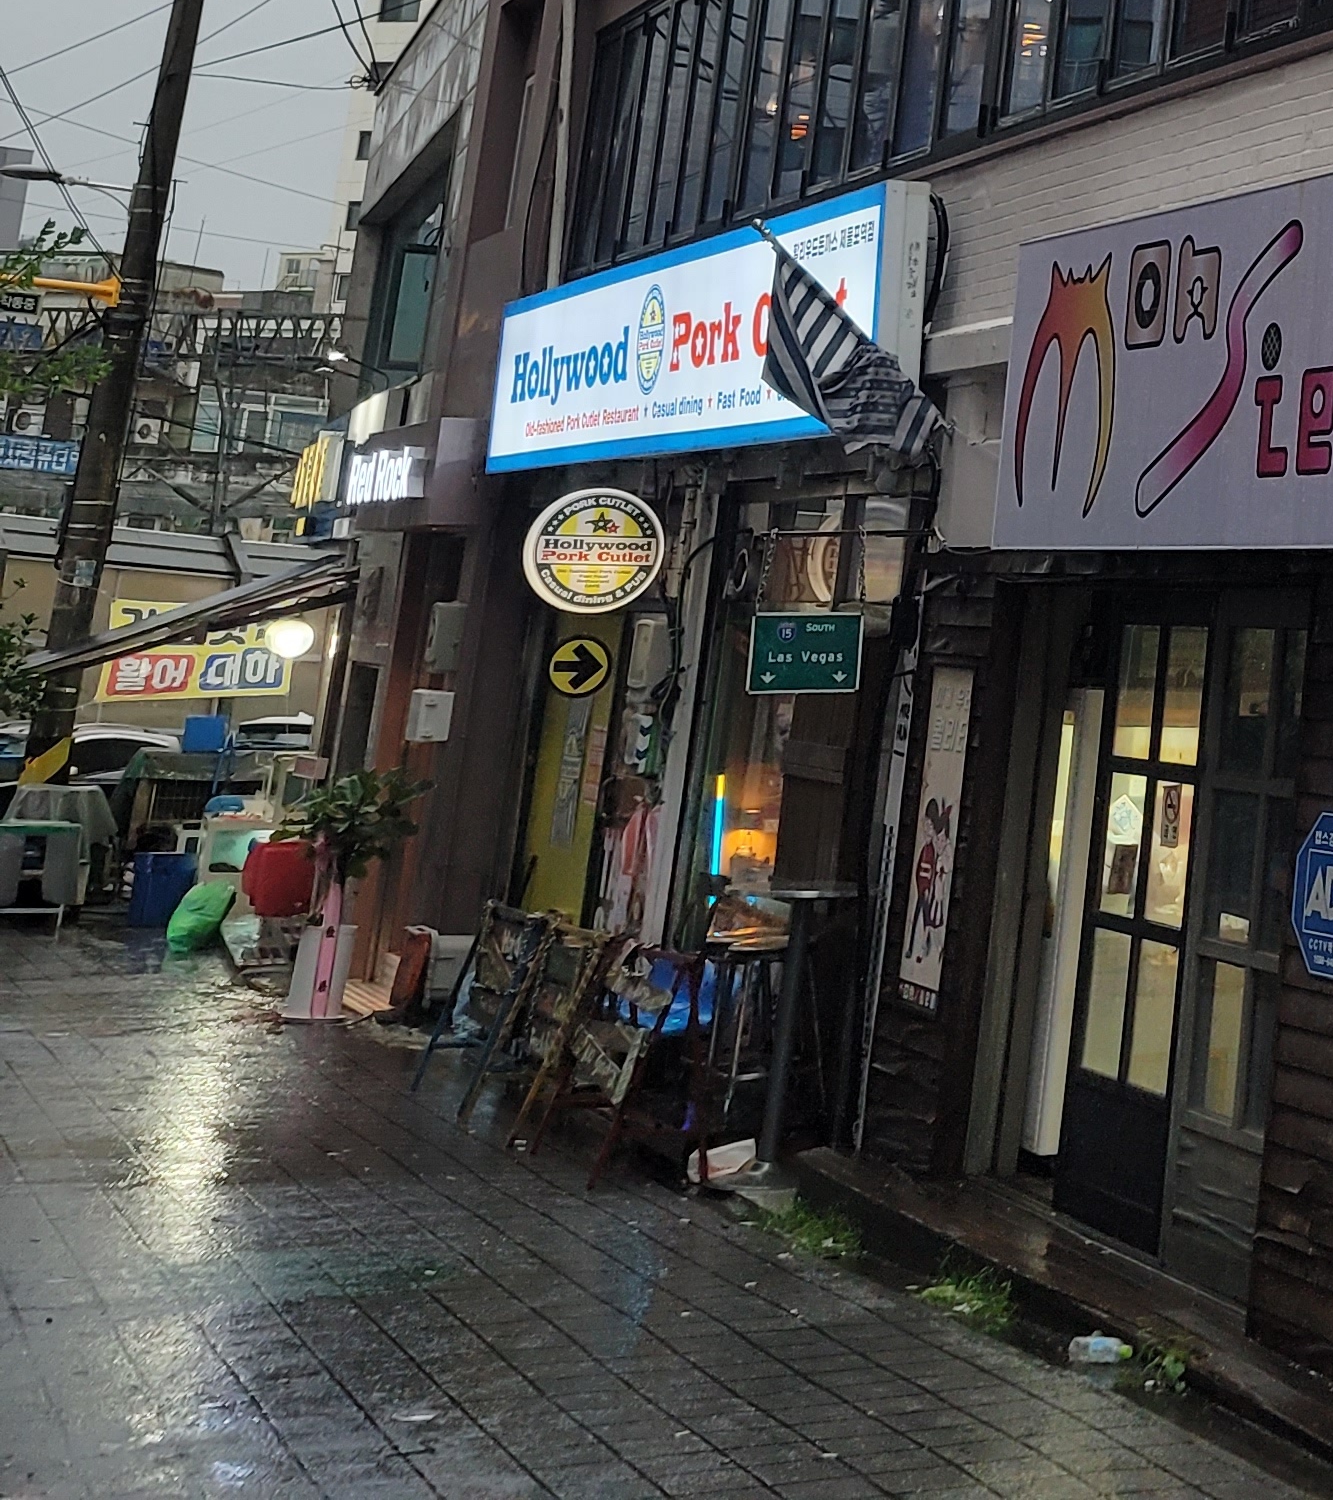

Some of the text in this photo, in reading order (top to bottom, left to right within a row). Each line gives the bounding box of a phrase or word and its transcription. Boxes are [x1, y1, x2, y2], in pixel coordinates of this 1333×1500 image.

[511, 325, 629, 404] Hollywood
[670, 301, 742, 372] Pork
[567, 413, 581, 431] Pork
[582, 410, 601, 428] Cutlet
[602, 405, 639, 424] Restaurant
[651, 399, 677, 419] Casual
[678, 396, 703, 417] dining
[717, 390, 736, 410] Fast
[739, 388, 761, 407] Food
[346, 452, 378, 505] Red
[373, 446, 413, 502] Rock
[563, 497, 641, 517] PORK CUTLET
[543, 538, 652, 552] Hollywood
[541, 551, 651, 563] Pork Cutlet
[782, 629, 792, 638] 15
[806, 623, 835, 632] SOUTH
[768, 651, 843, 665] Las Vegas
